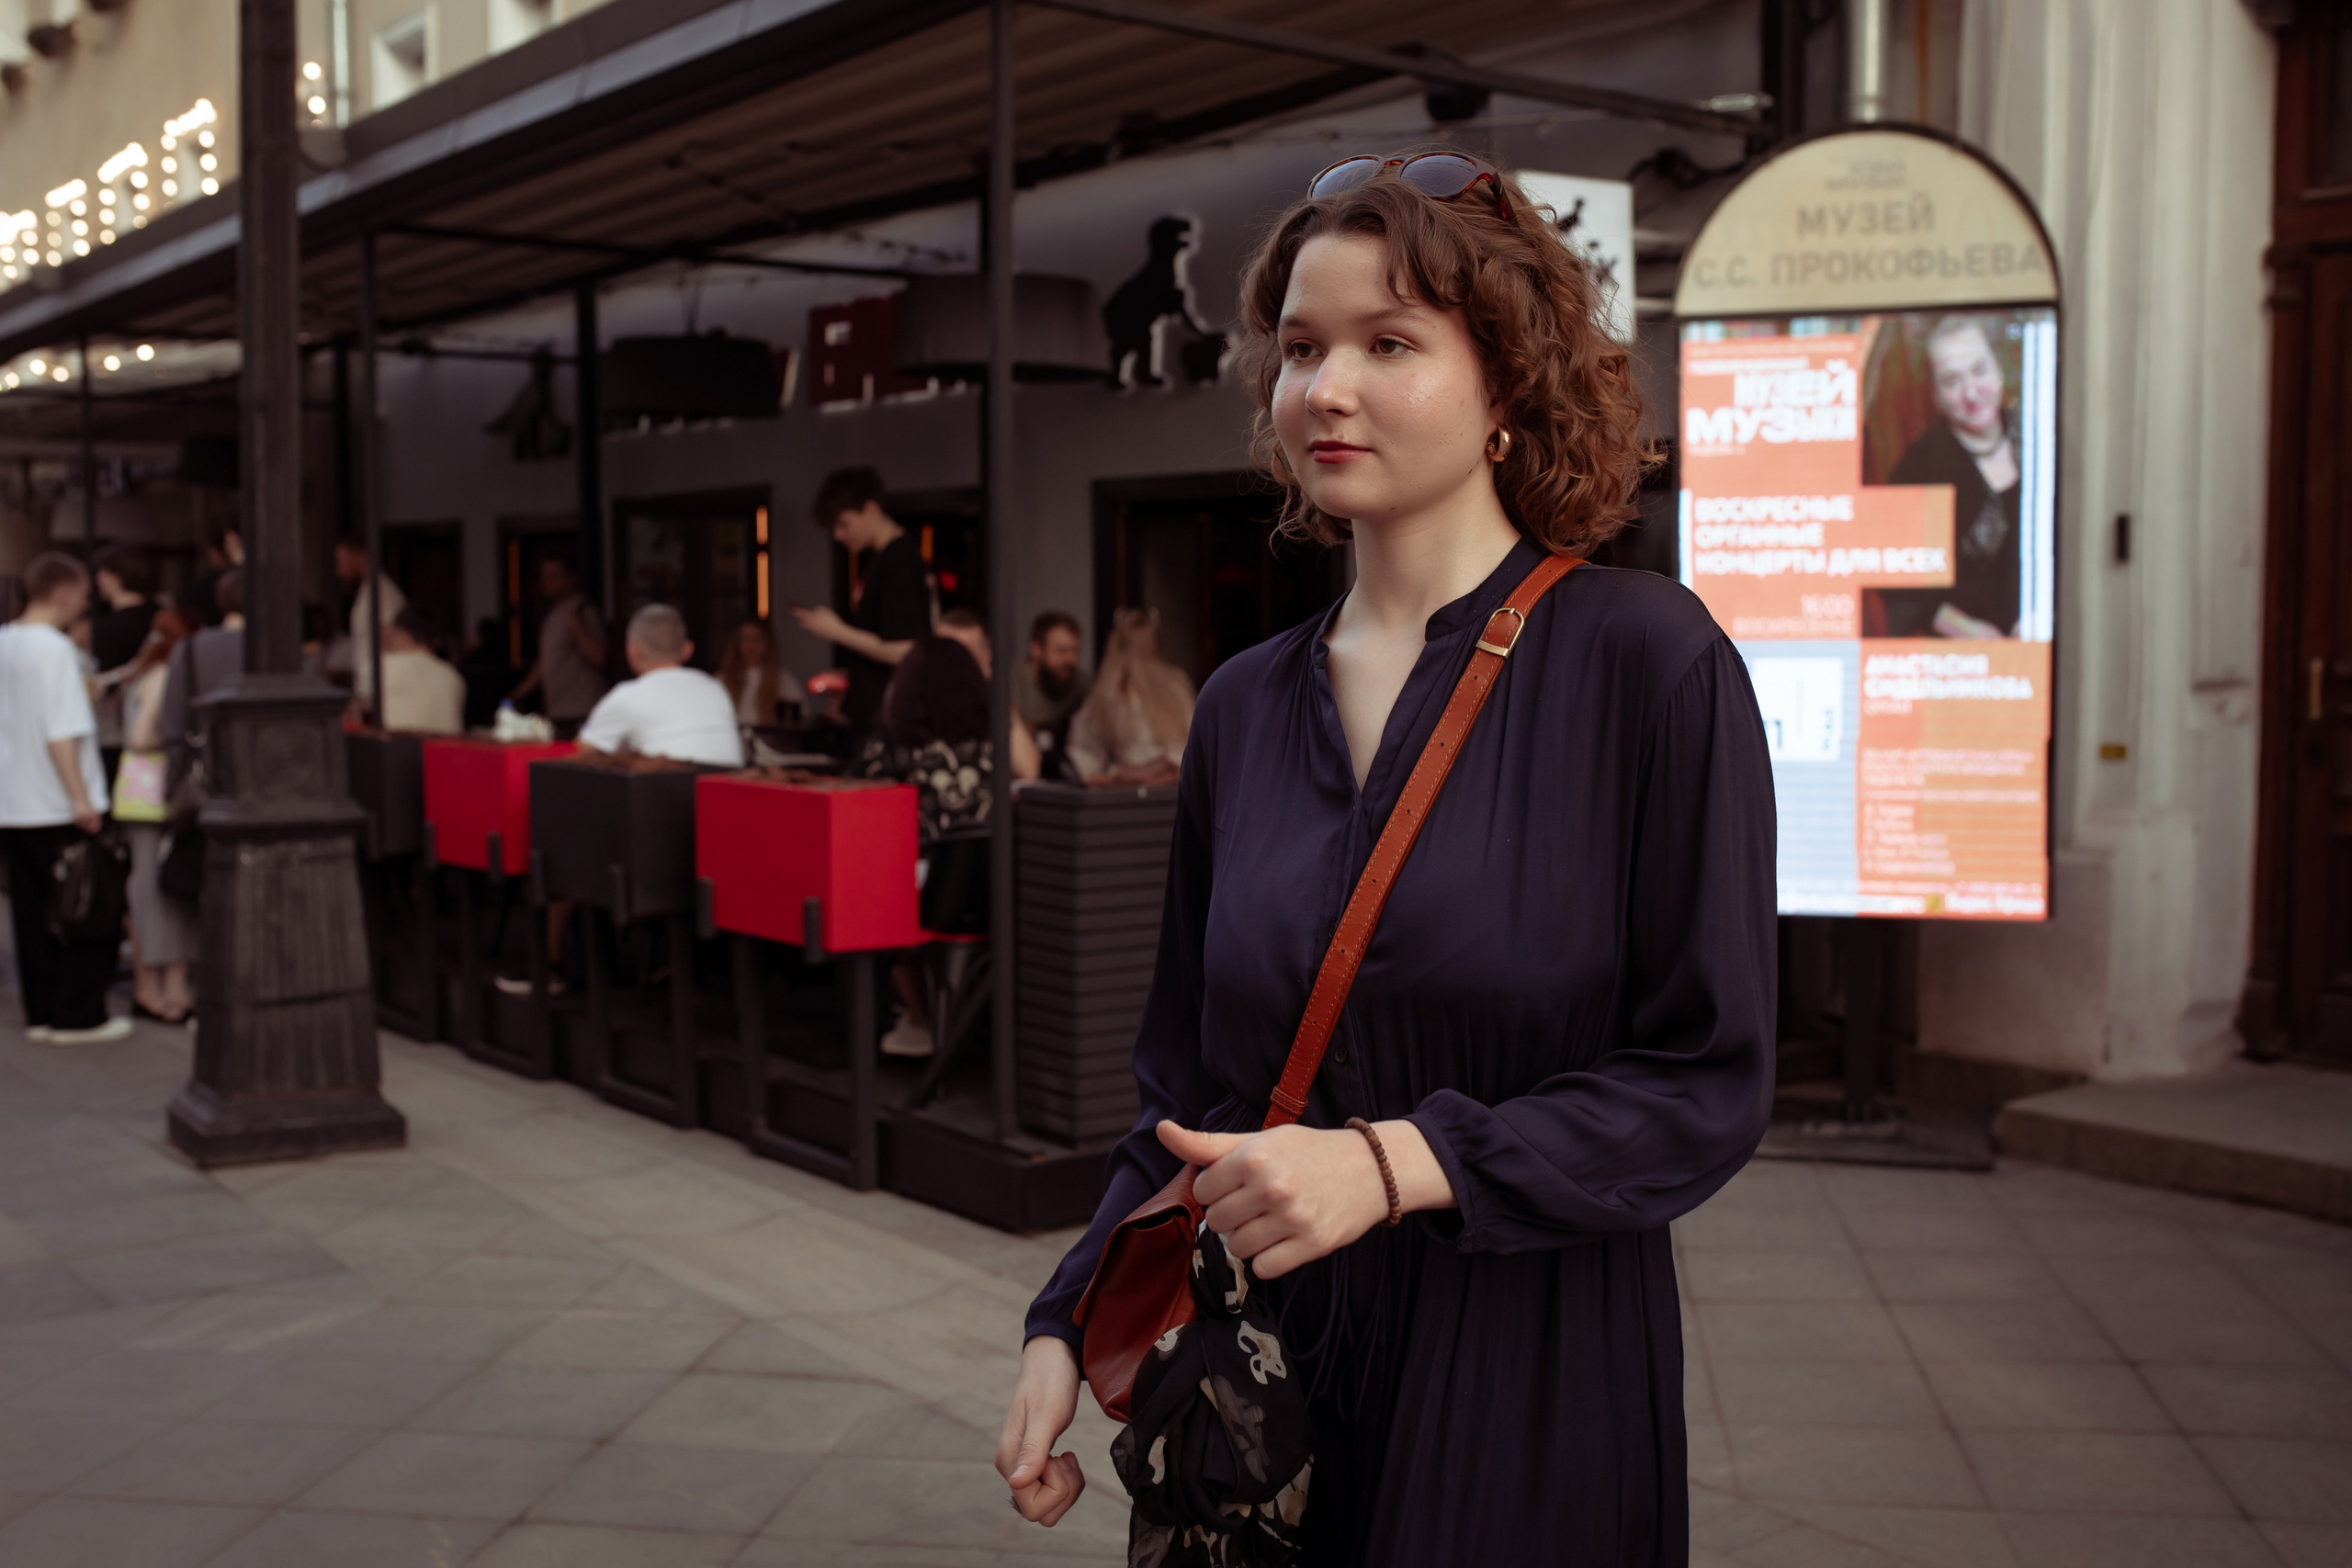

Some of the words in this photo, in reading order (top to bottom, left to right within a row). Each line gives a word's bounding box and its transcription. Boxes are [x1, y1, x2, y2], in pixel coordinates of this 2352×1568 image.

[1797, 192, 1935, 239] МУЗЕЙ
[1770, 242, 2045, 286] ПРОКОФЬЕВА
[1827, 548, 1882, 577] ДЛЯ
[1883, 547, 1947, 573] ВСЕХ
